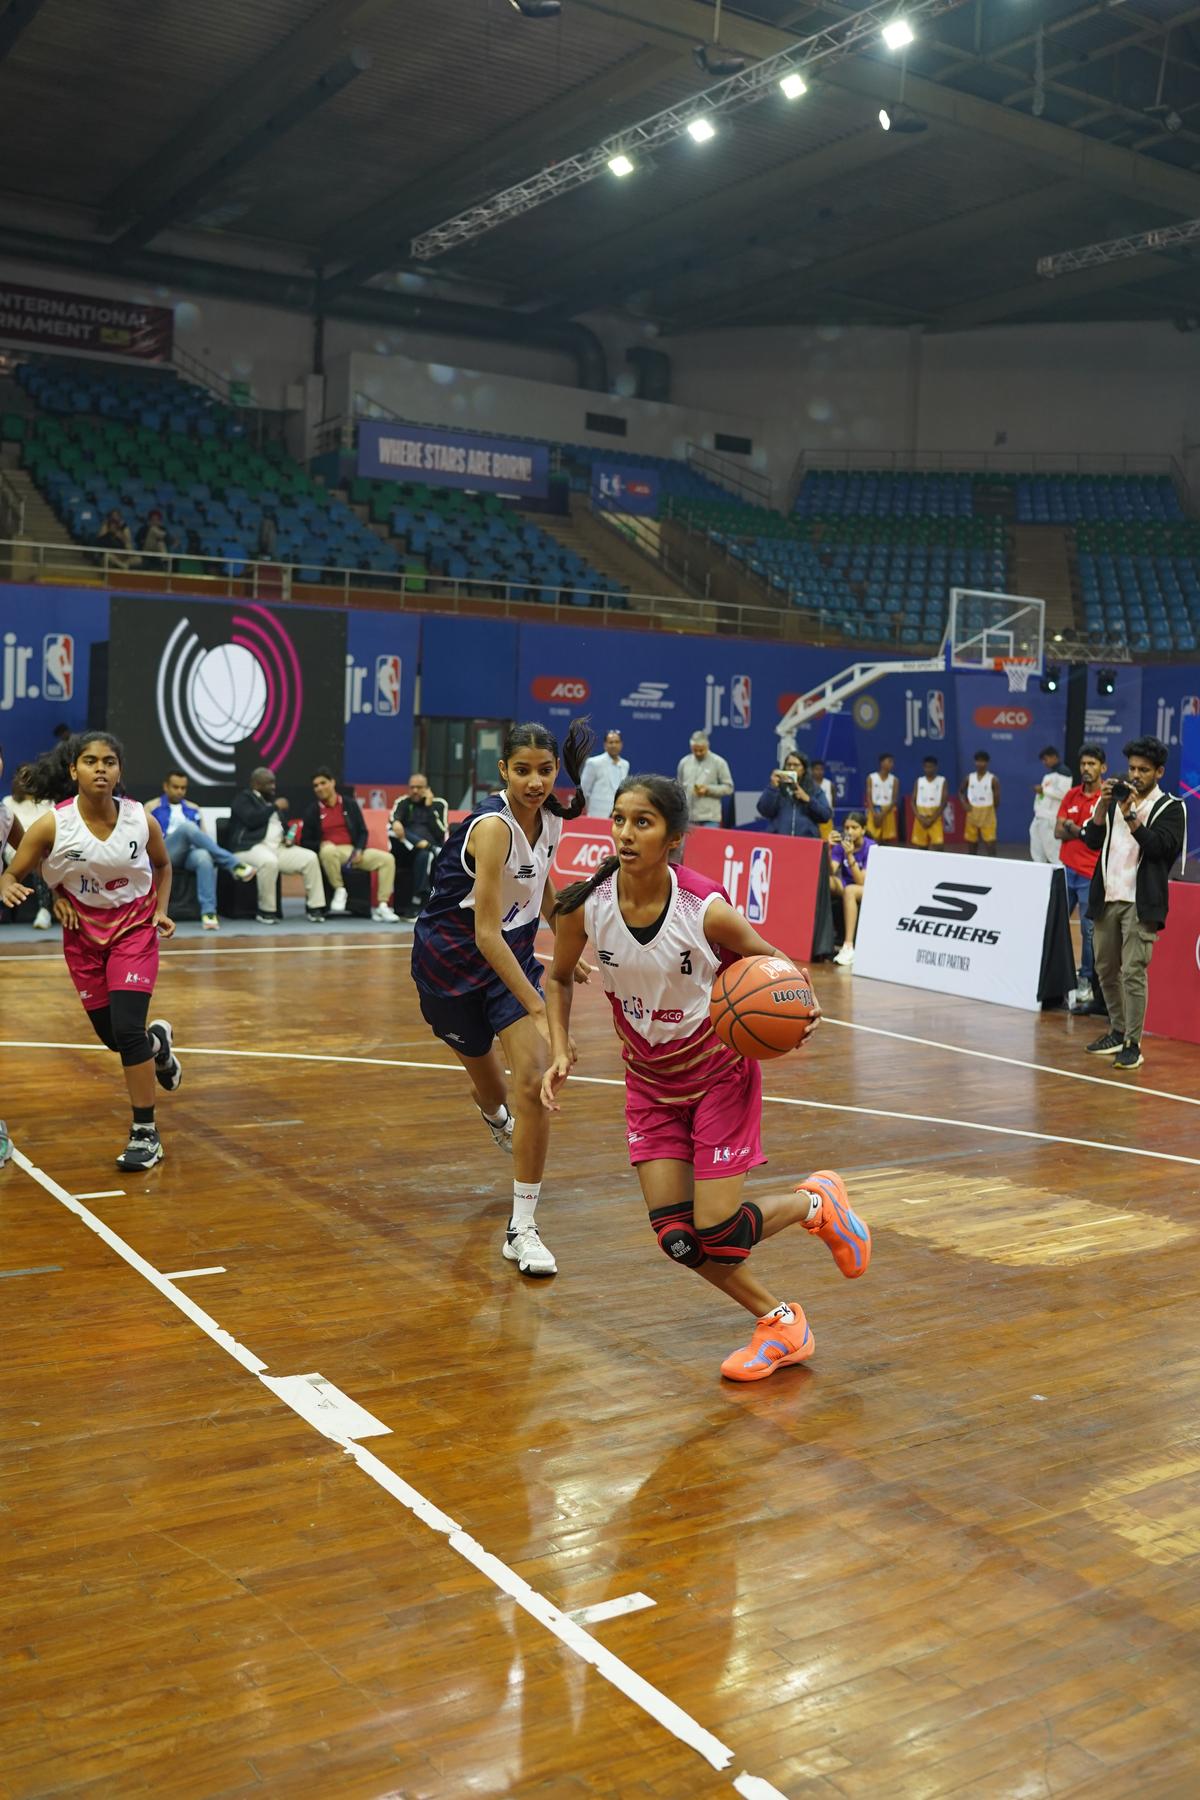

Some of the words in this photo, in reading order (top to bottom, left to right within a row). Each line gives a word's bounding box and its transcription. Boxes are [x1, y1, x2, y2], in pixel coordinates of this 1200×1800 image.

[378, 437, 422, 468] WHERE
[424, 443, 466, 474] STARS
[467, 449, 491, 476] ARE
[1, 632, 40, 710] jr.
[344, 654, 373, 724] jr.
[551, 683, 586, 698] ACG
[704, 674, 729, 735] jr.
[904, 689, 927, 746] jr.
[993, 711, 1028, 725] ACG
[129, 840, 139, 859] 2
[572, 843, 610, 866] ACG
[896, 917, 1001, 945] SKECHERS
[680, 950, 692, 975] 3
[916, 949, 937, 967] OFFICIAL
[937, 952, 947, 967] KIT
[946, 953, 971, 971] PARTNER
[660, 1012, 682, 1021] ACG
